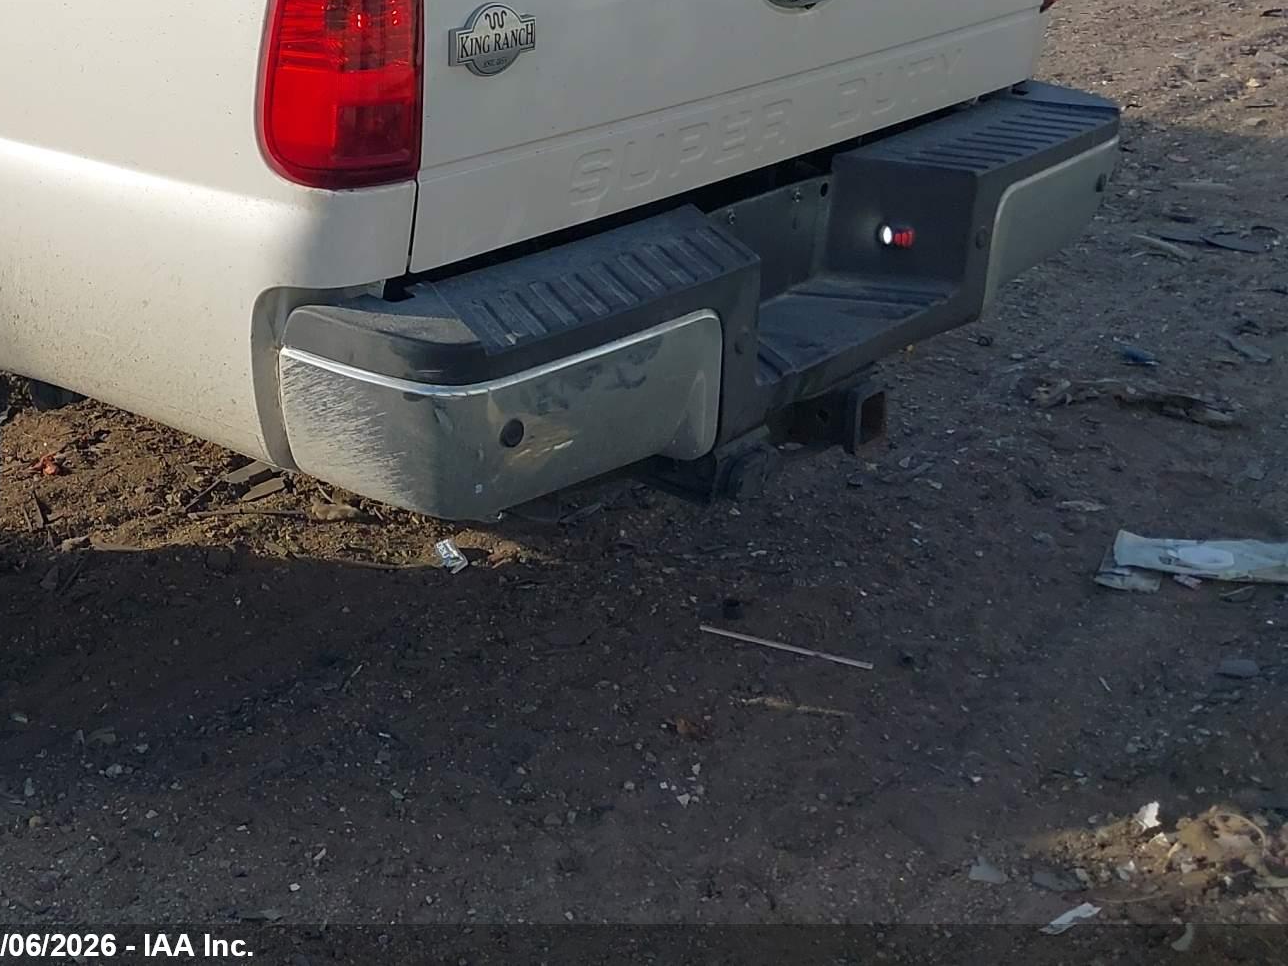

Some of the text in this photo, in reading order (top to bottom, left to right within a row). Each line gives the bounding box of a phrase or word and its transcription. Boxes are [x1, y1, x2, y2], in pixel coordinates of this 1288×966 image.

[459, 22, 535, 59] KING RANCH
[568, 97, 794, 207] SUPER
